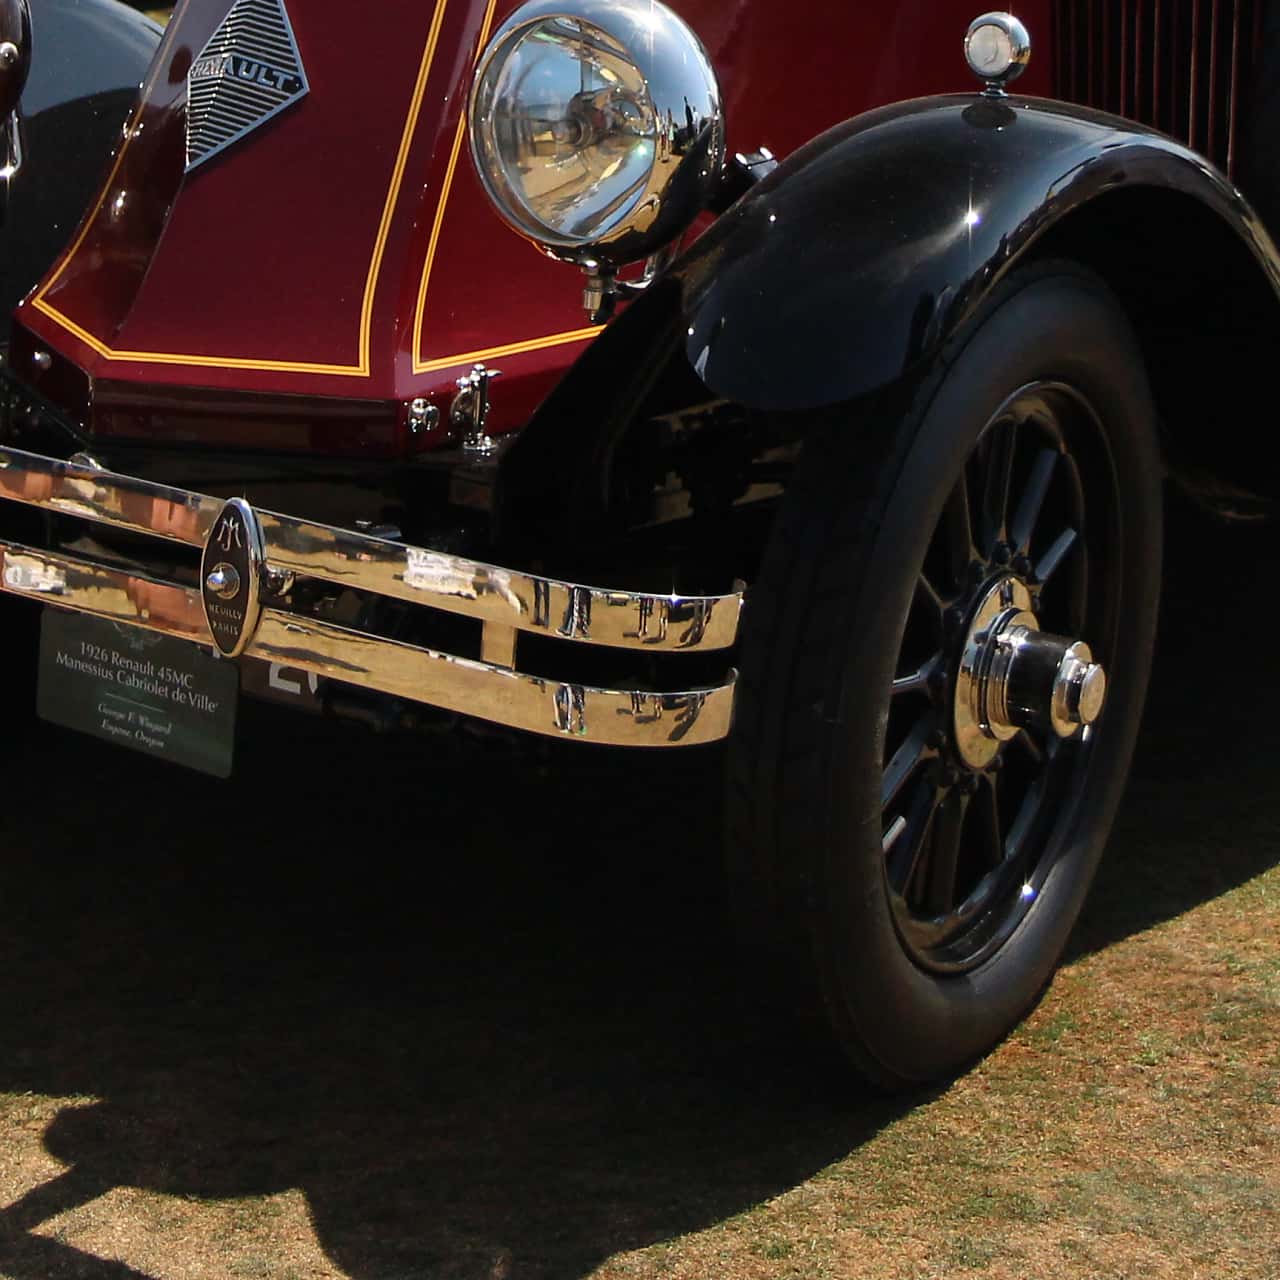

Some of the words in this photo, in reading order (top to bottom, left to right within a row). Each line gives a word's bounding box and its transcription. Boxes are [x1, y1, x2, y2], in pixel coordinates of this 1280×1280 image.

[192, 54, 295, 90] RENAULT
[55, 650, 114, 681] Manessius
[116, 670, 169, 698] Cabriolet
[171, 687, 187, 704] de
[80, 641, 109, 663] 1926
[111, 650, 155, 677] Renault
[157, 666, 194, 689] 45MC
